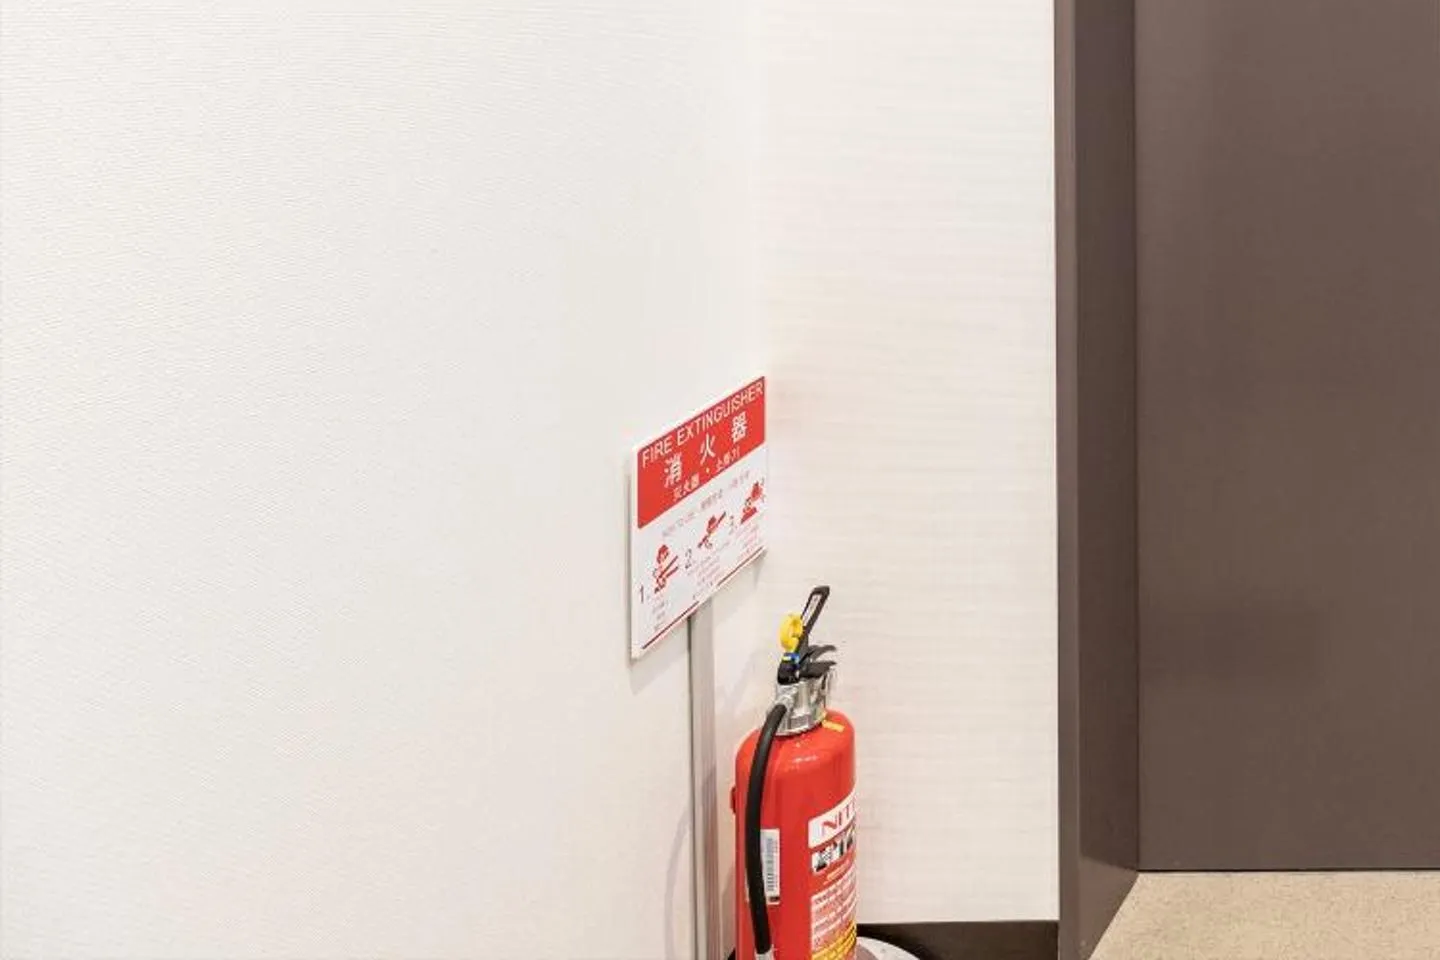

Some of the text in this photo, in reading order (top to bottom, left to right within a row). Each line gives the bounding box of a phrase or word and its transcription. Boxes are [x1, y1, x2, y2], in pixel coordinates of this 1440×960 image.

[642, 381, 764, 469] FIRE EXTINGUISHER
[664, 411, 748, 489] 消火器
